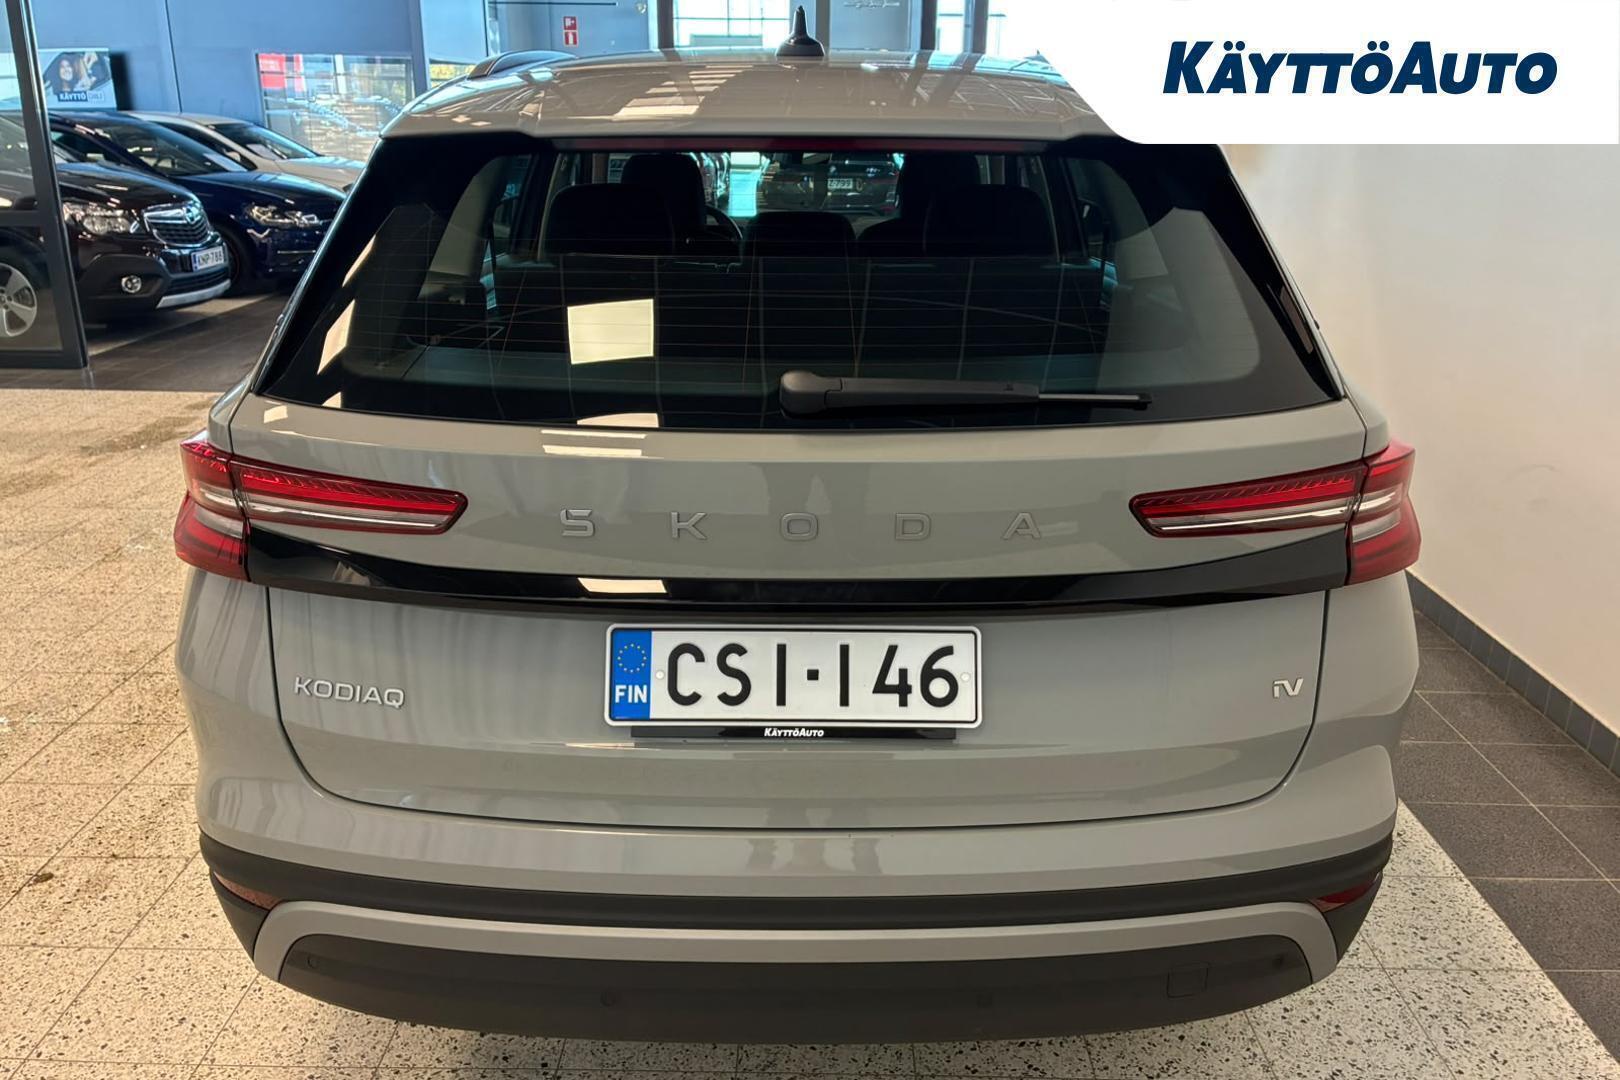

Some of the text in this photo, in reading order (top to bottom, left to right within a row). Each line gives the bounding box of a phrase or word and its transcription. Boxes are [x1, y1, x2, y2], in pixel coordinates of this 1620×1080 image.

[667, 643, 959, 708] CSI-146
[294, 676, 404, 709] KODIAQ
[614, 684, 648, 704] FIN
